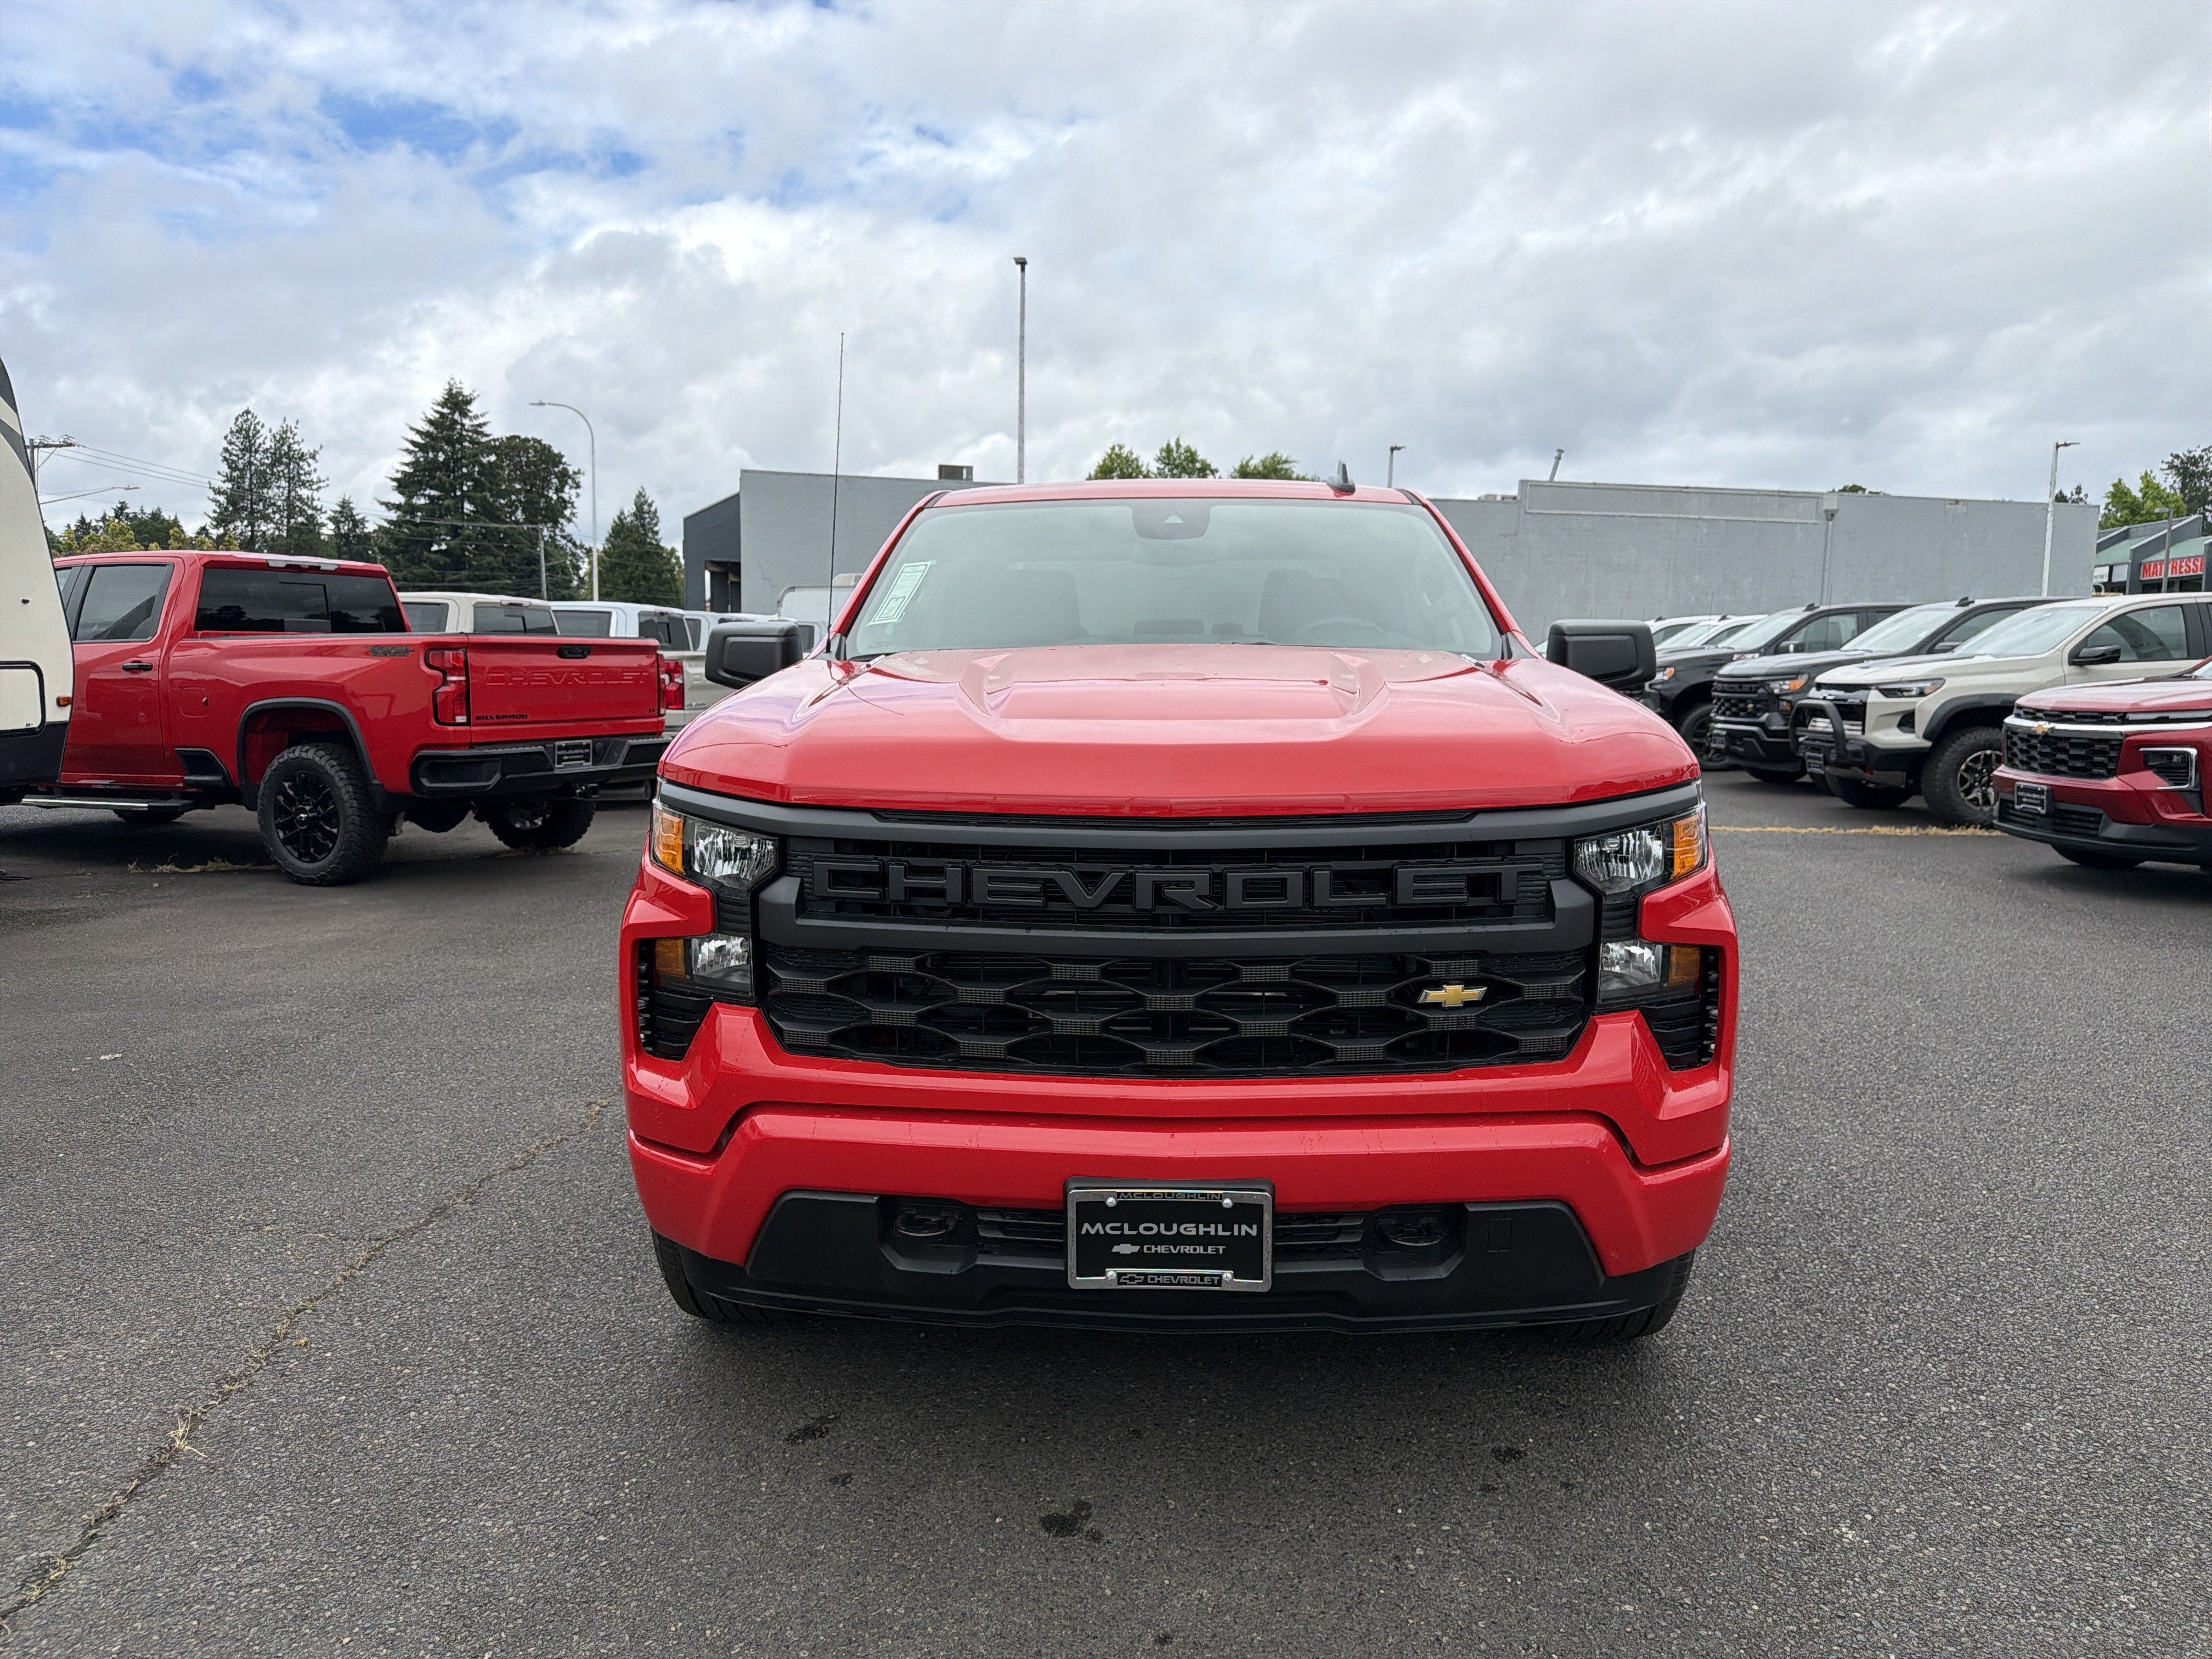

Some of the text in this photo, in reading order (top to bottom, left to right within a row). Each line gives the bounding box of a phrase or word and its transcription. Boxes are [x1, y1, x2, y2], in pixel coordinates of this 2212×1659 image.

[2142, 556, 2204, 578] MATRESSE
[486, 672, 648, 685] CHEVROLET
[812, 857, 1544, 911] CHEVROLET
[1081, 1222, 1257, 1237] MCLOUGHLIN
[1143, 1245, 1226, 1254] CHEVROLET
[1147, 1274, 1220, 1285] CHEVROLET
